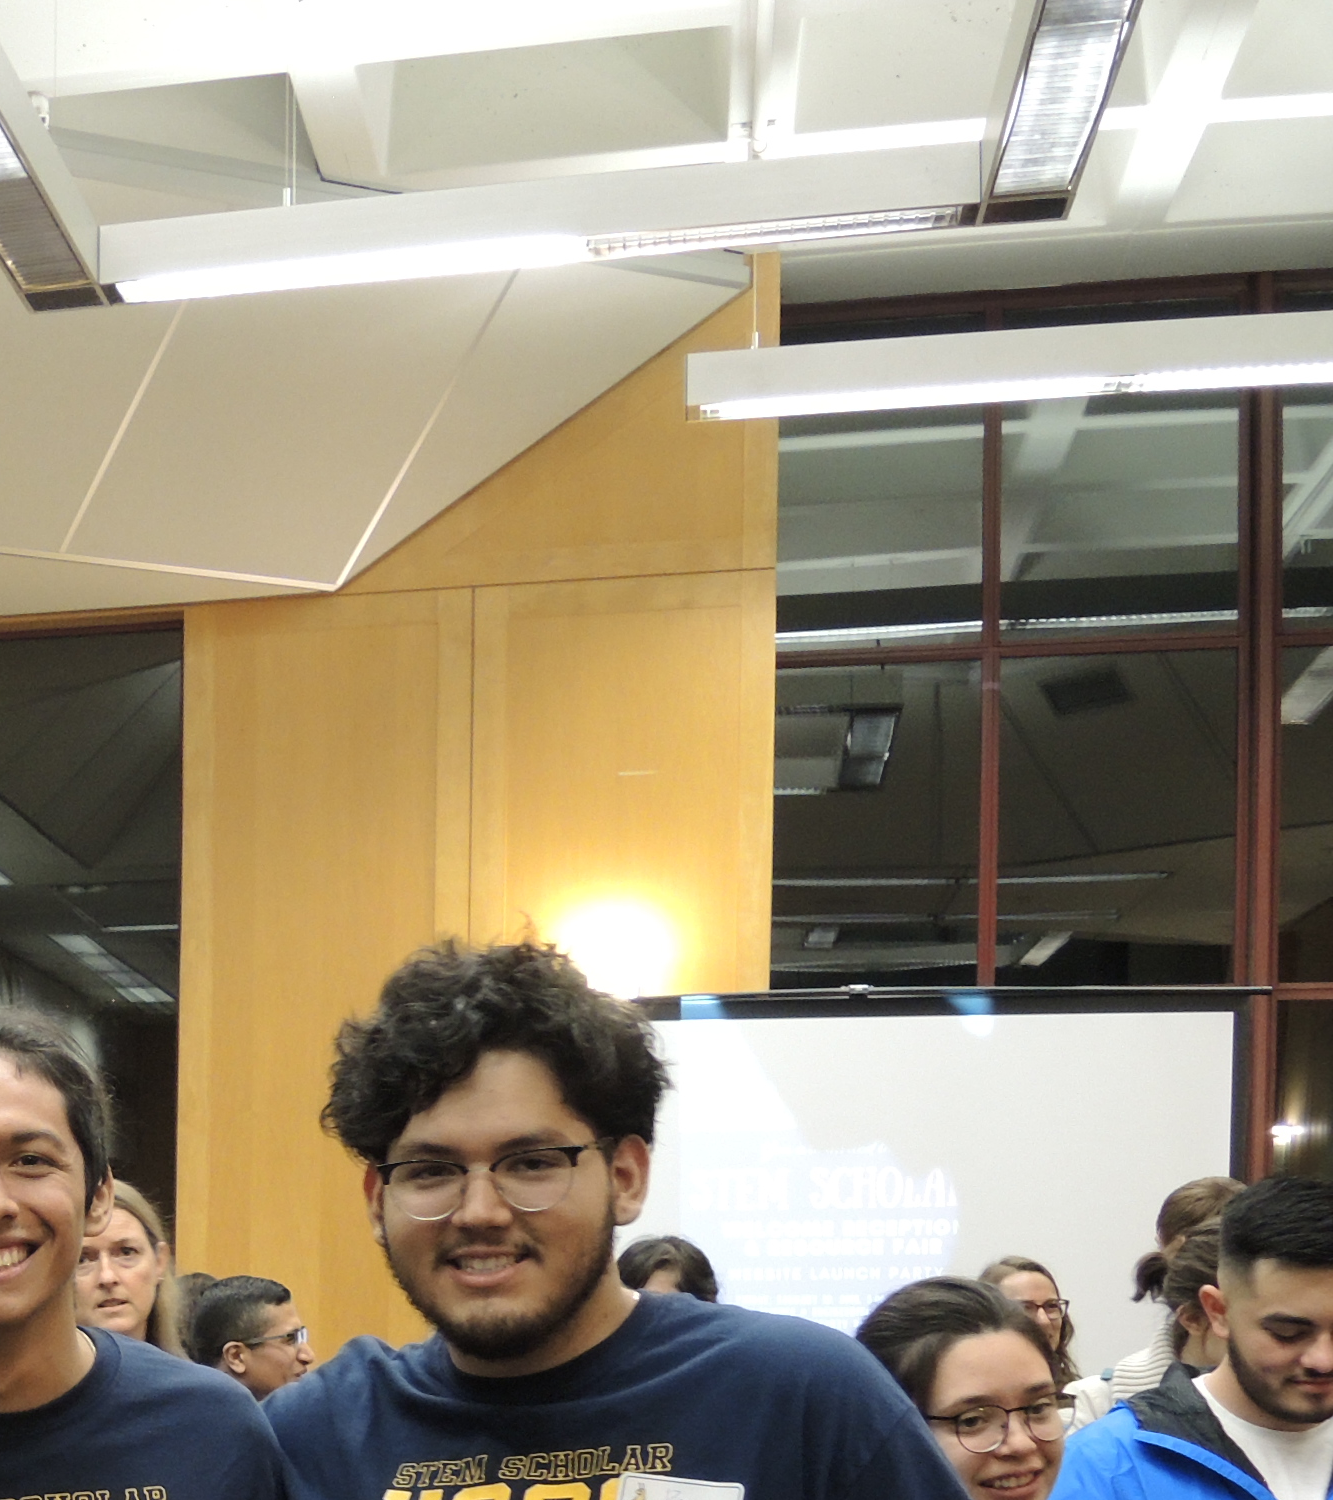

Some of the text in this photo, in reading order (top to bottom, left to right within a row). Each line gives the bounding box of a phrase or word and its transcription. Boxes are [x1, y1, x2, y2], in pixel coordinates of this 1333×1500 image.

[689, 1168, 789, 1210] STEM
[892, 1238, 943, 1255] FAIR
[811, 1267, 881, 1281] LAUNCH
[888, 1266, 945, 1280] PARTY
[392, 1442, 673, 1488] STEM SCHOLAR
